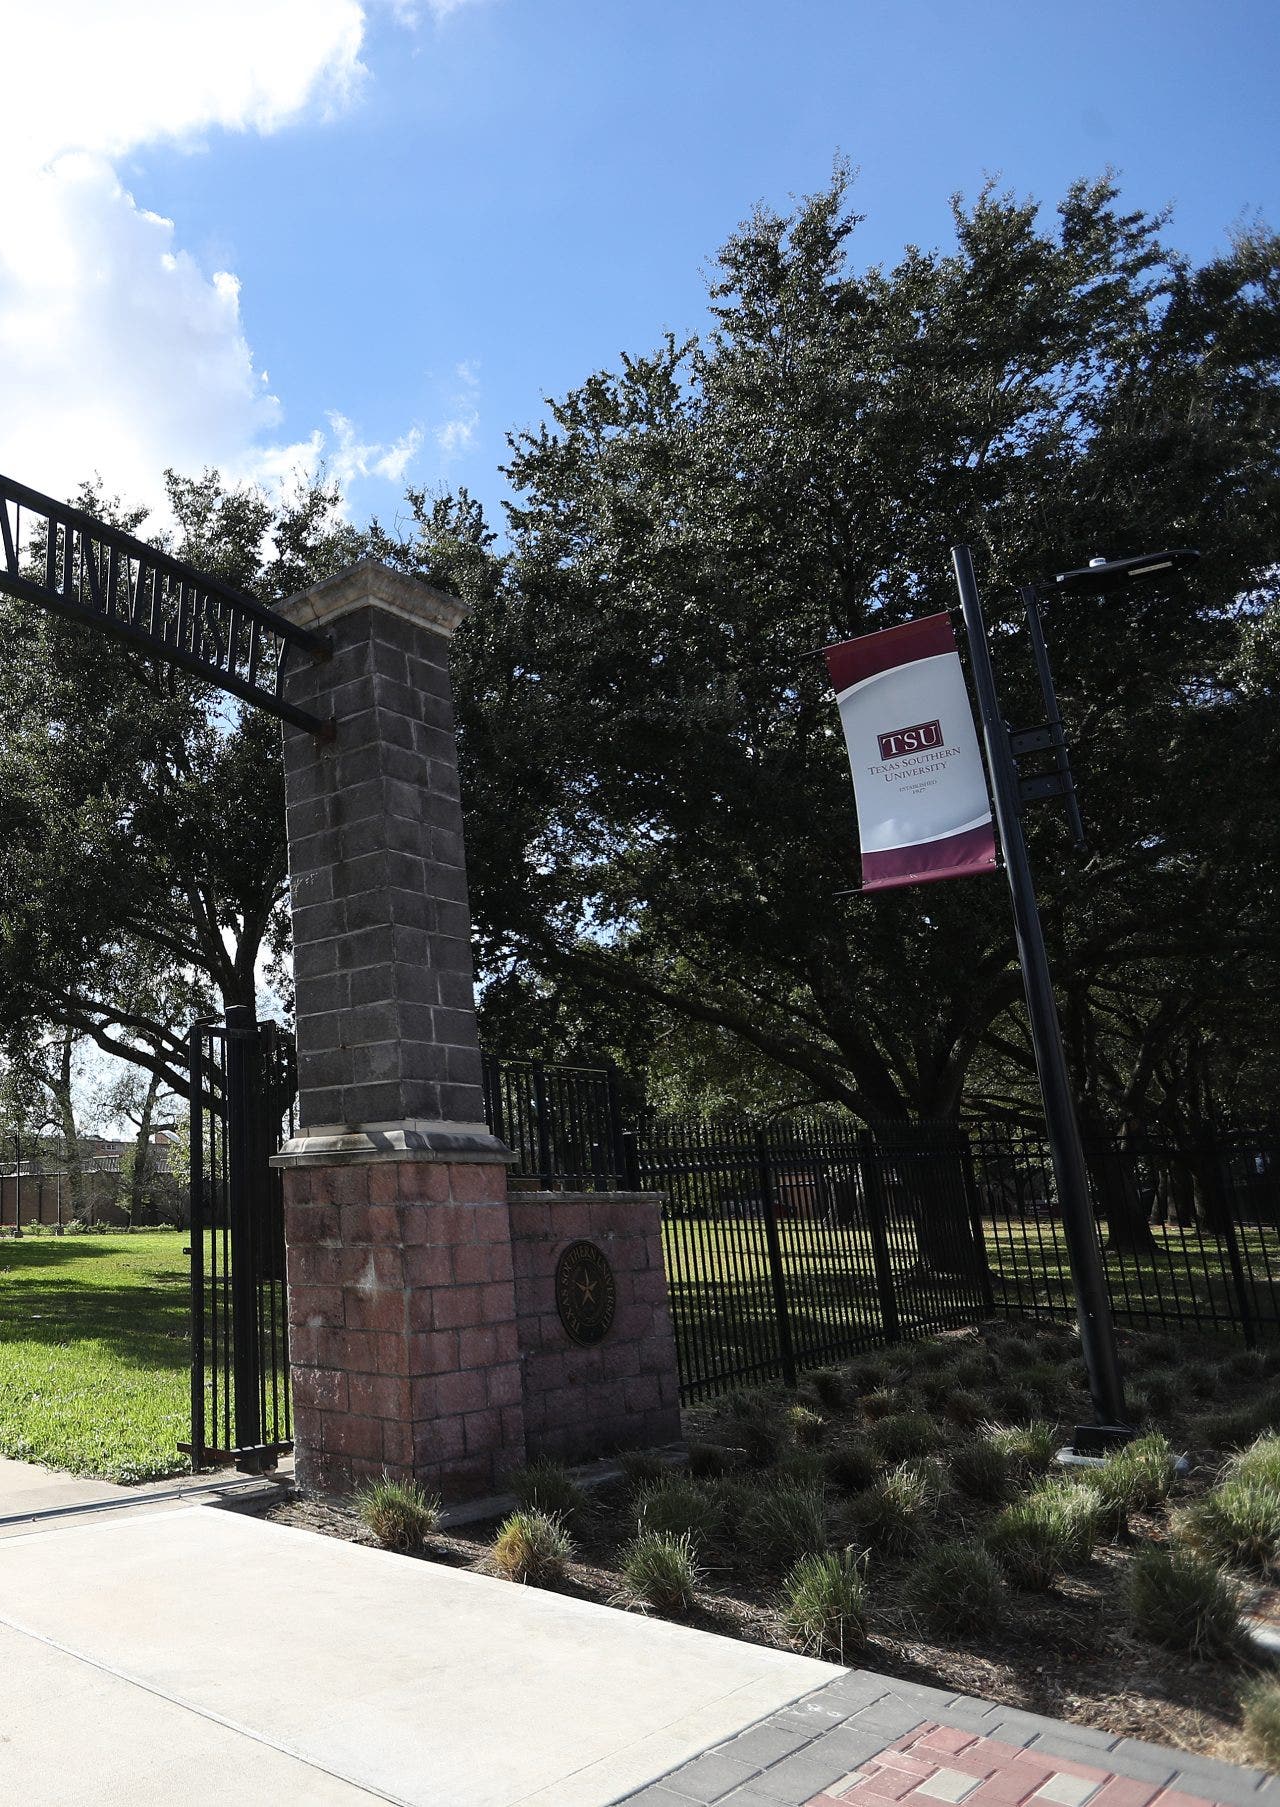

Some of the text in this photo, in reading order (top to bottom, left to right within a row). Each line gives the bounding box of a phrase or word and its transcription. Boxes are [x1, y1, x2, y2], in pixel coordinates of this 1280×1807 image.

[44, 514, 288, 698] UNIVERSITY
[882, 726, 936, 754] TSU
[869, 747, 960, 775] TEXAS SOUTHERN
[884, 761, 947, 782] UNIVERSITY
